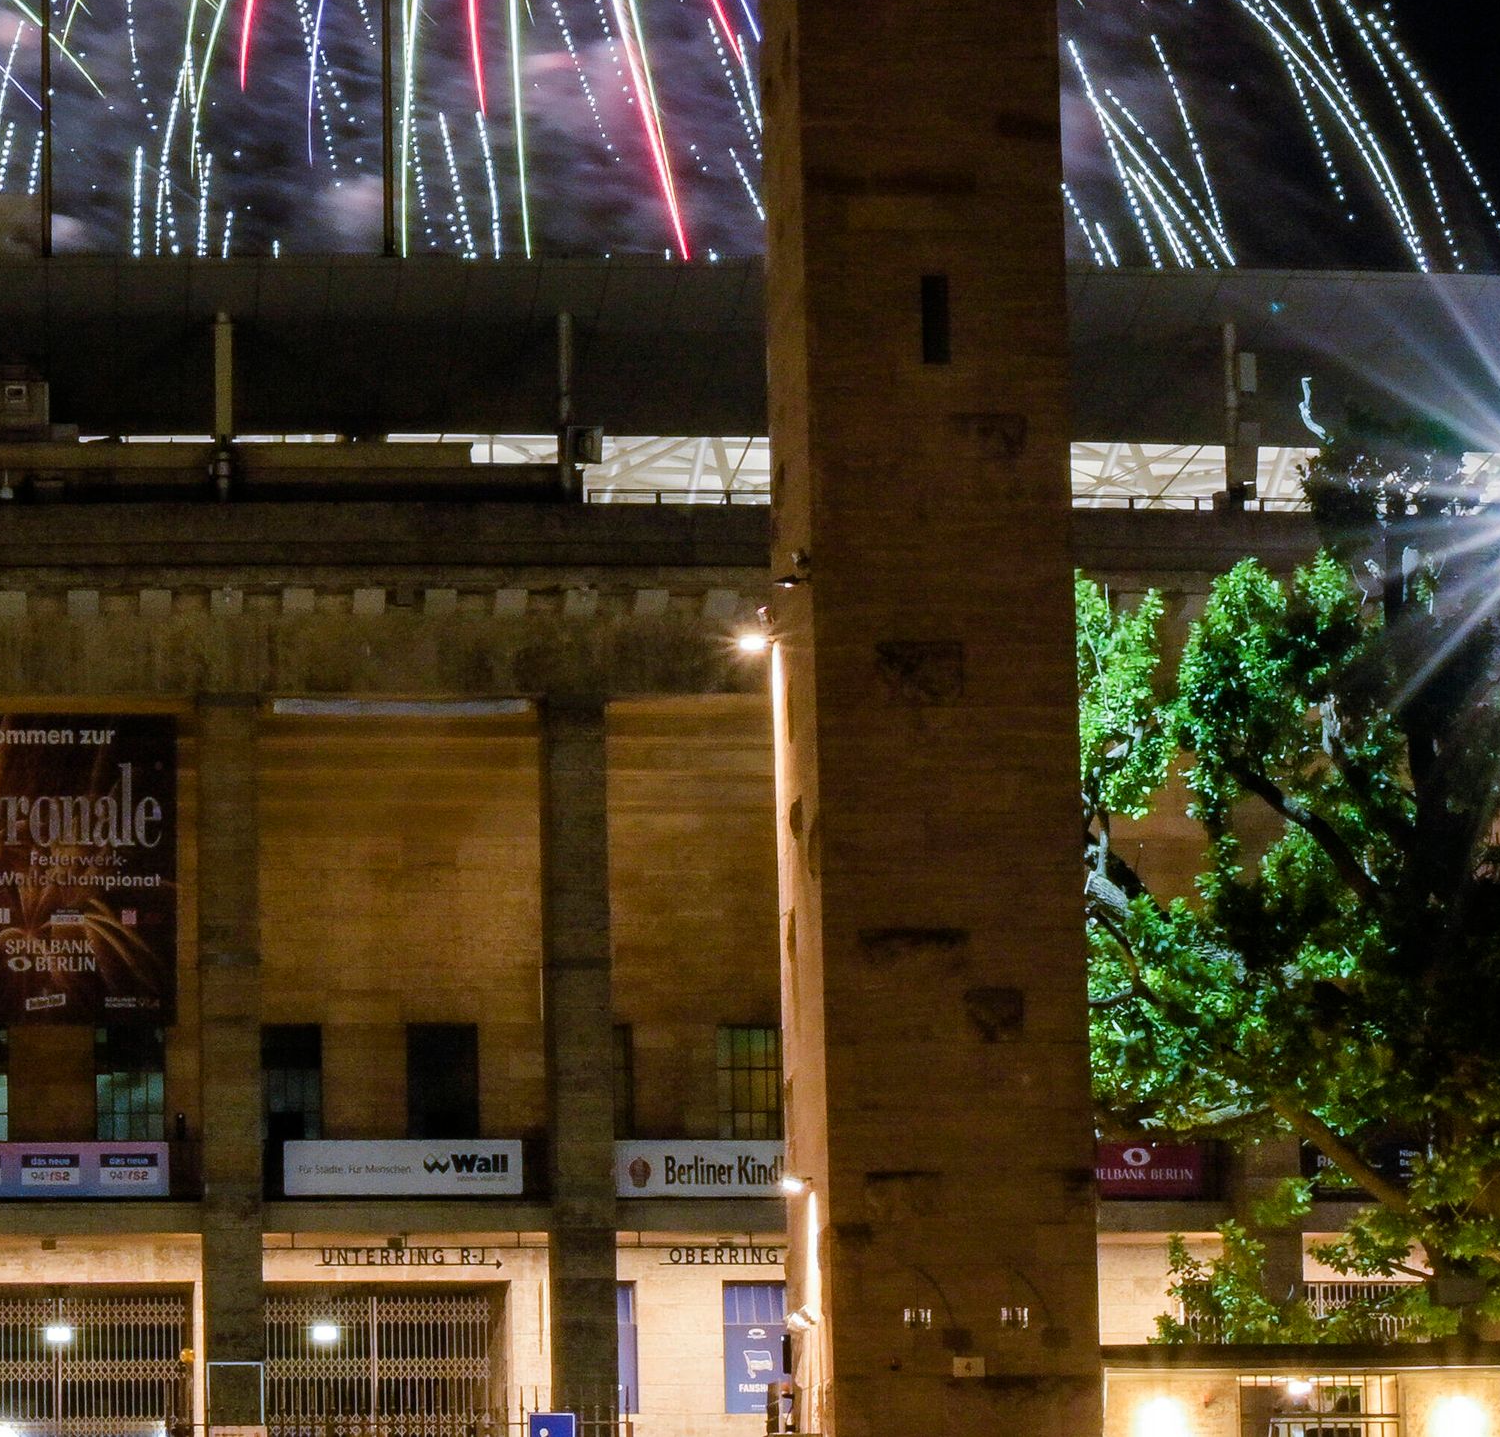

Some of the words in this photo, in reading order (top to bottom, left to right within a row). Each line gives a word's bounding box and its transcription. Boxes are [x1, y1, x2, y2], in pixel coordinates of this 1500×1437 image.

[79, 727, 116, 746] zur
[5, 940, 96, 956] SPIELBANK
[35, 957, 97, 972] BERLIN
[450, 1154, 508, 1173] Wall
[664, 1155, 734, 1185] Berliner
[1095, 1168, 1146, 1180] IELBANK
[1150, 1168, 1193, 1180] BERLIN
[321, 1248, 444, 1265] UNTERRING
[460, 1248, 486, 1264] R-J
[669, 1248, 778, 1264] OBERRING
[738, 1384, 768, 1393] FANSH
